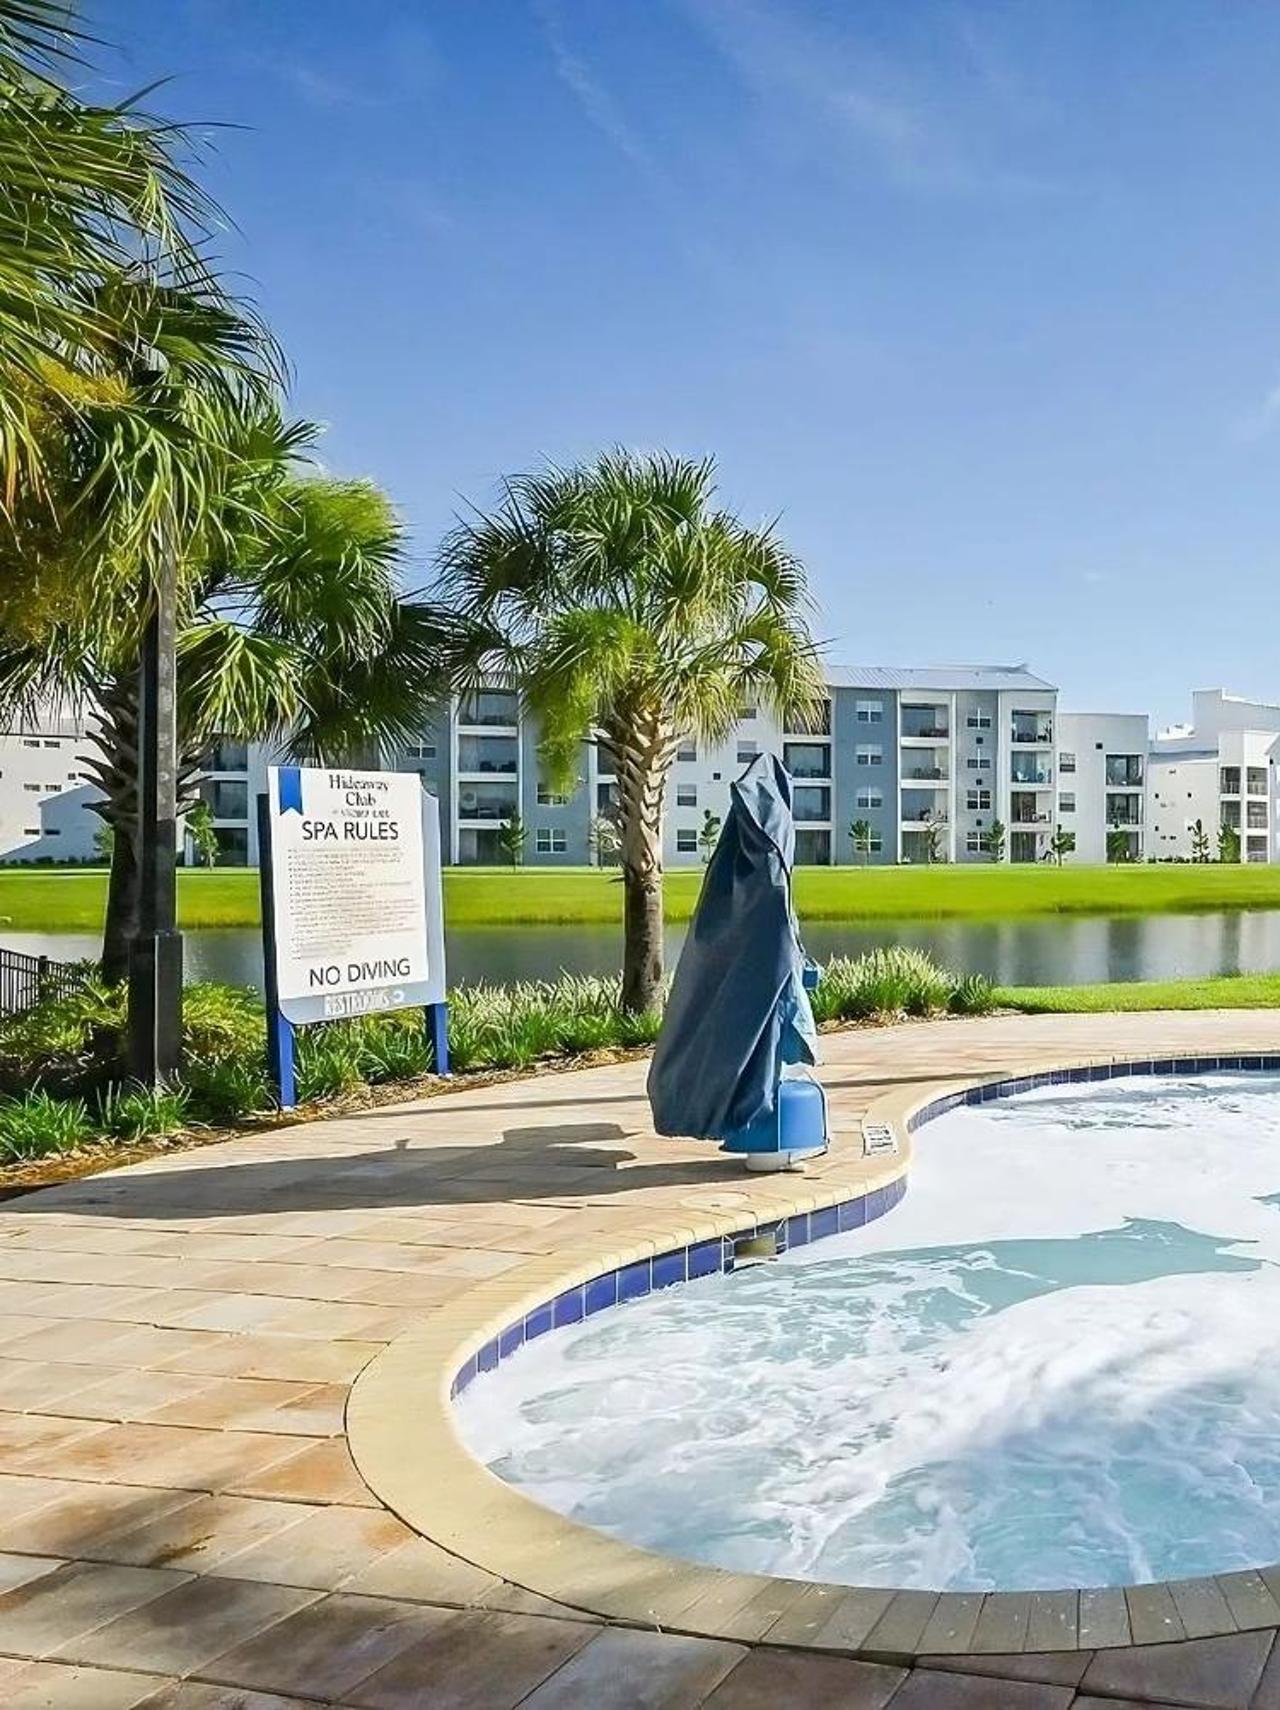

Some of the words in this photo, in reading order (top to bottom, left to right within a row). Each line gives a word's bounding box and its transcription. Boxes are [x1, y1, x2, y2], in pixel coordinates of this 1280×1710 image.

[329, 774, 389, 792] Hideaway
[346, 792, 376, 807] Club
[302, 820, 338, 840] SPA
[344, 821, 399, 841] RULES
[309, 965, 341, 987] NO
[347, 958, 410, 983] DIVING
